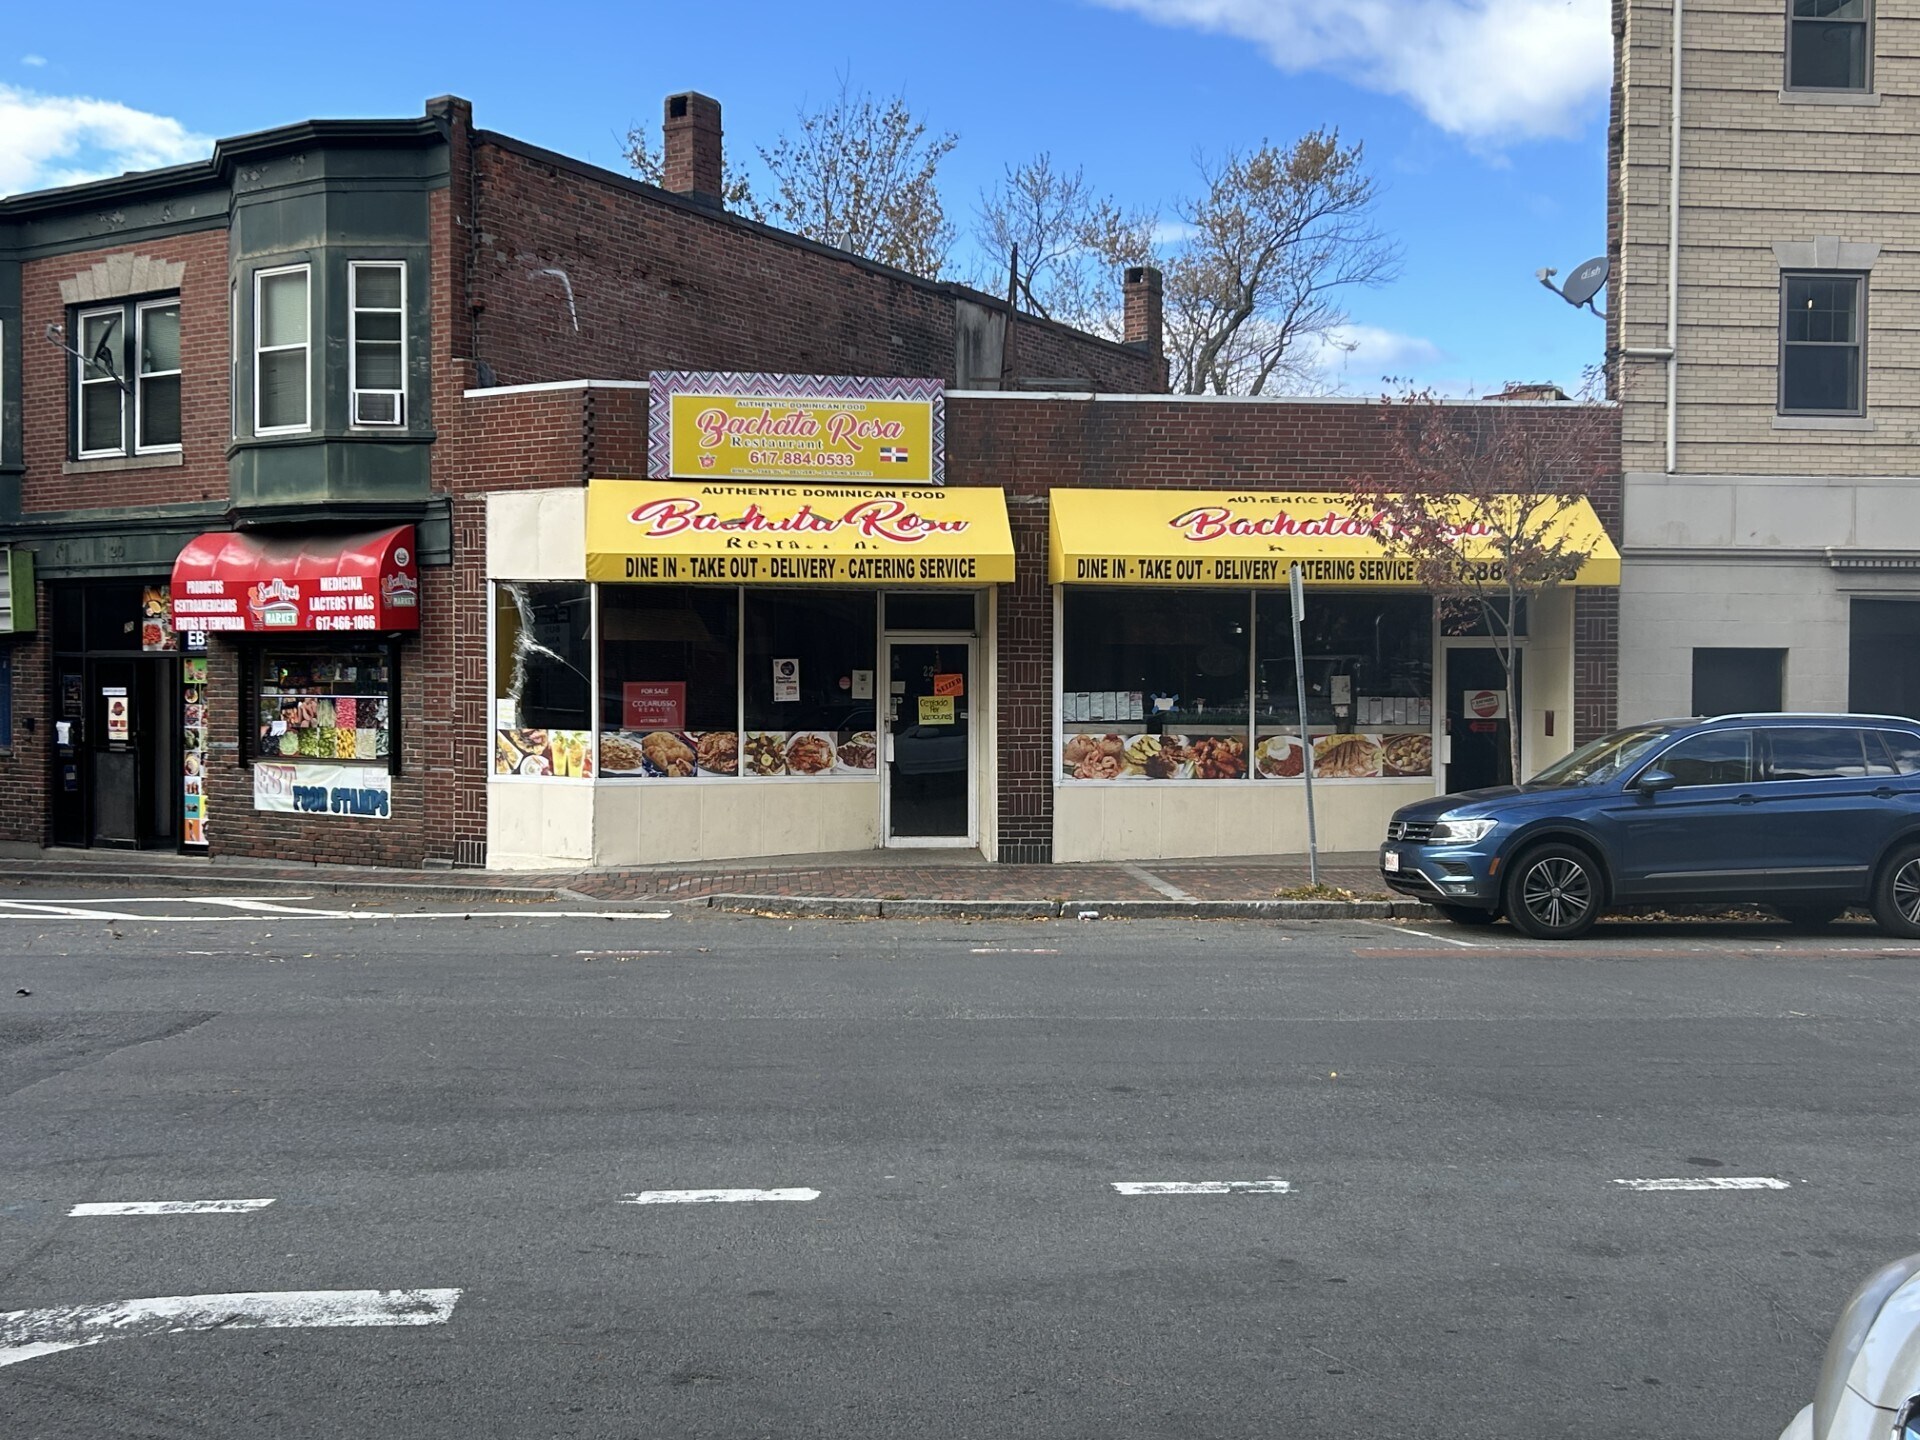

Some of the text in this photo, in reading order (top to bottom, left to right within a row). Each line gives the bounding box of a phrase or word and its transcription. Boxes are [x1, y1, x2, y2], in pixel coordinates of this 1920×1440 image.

[1580, 265, 1601, 280] dish
[736, 401, 788, 409] AUTHENTIC
[789, 402, 840, 410] DOMINICAN
[696, 408, 905, 452] Bachata Rosa
[730, 435, 824, 450] Restaurant
[749, 451, 855, 467] 617.884.0533
[701, 486, 946, 499] AUTHENTIC DOMINICAN FOOD
[1168, 506, 1372, 542] Bachata
[625, 557, 976, 579] DINE IN TAKE OUT DELIVERY CATERING SERVICE
[1077, 558, 1108, 579] DINE
[1112, 558, 1126, 579] IN
[1138, 559, 1172, 580] TAKE
[1176, 559, 1203, 580] OUT
[1215, 559, 1278, 580] DELIVERY
[1359, 560, 1414, 581] SERVICE
[186, 580, 224, 594] PRODUCTOS
[320, 576, 363, 591] MEDICINA
[174, 599, 237, 613] CENTROAMERICANOS
[309, 593, 375, 611] LACTEOS Y MÁS
[175, 617, 246, 631] FRUTAS DE TEMPORADA
[265, 611, 296, 624] MARKET
[315, 615, 376, 630] 617-466-1066
[187, 630, 207, 646] EB
[936, 677, 962, 693] SEIZED
[632, 700, 677, 708] COLARUSSO
[257, 764, 298, 796] EBT
[292, 785, 389, 816] FOOD STAMPS
